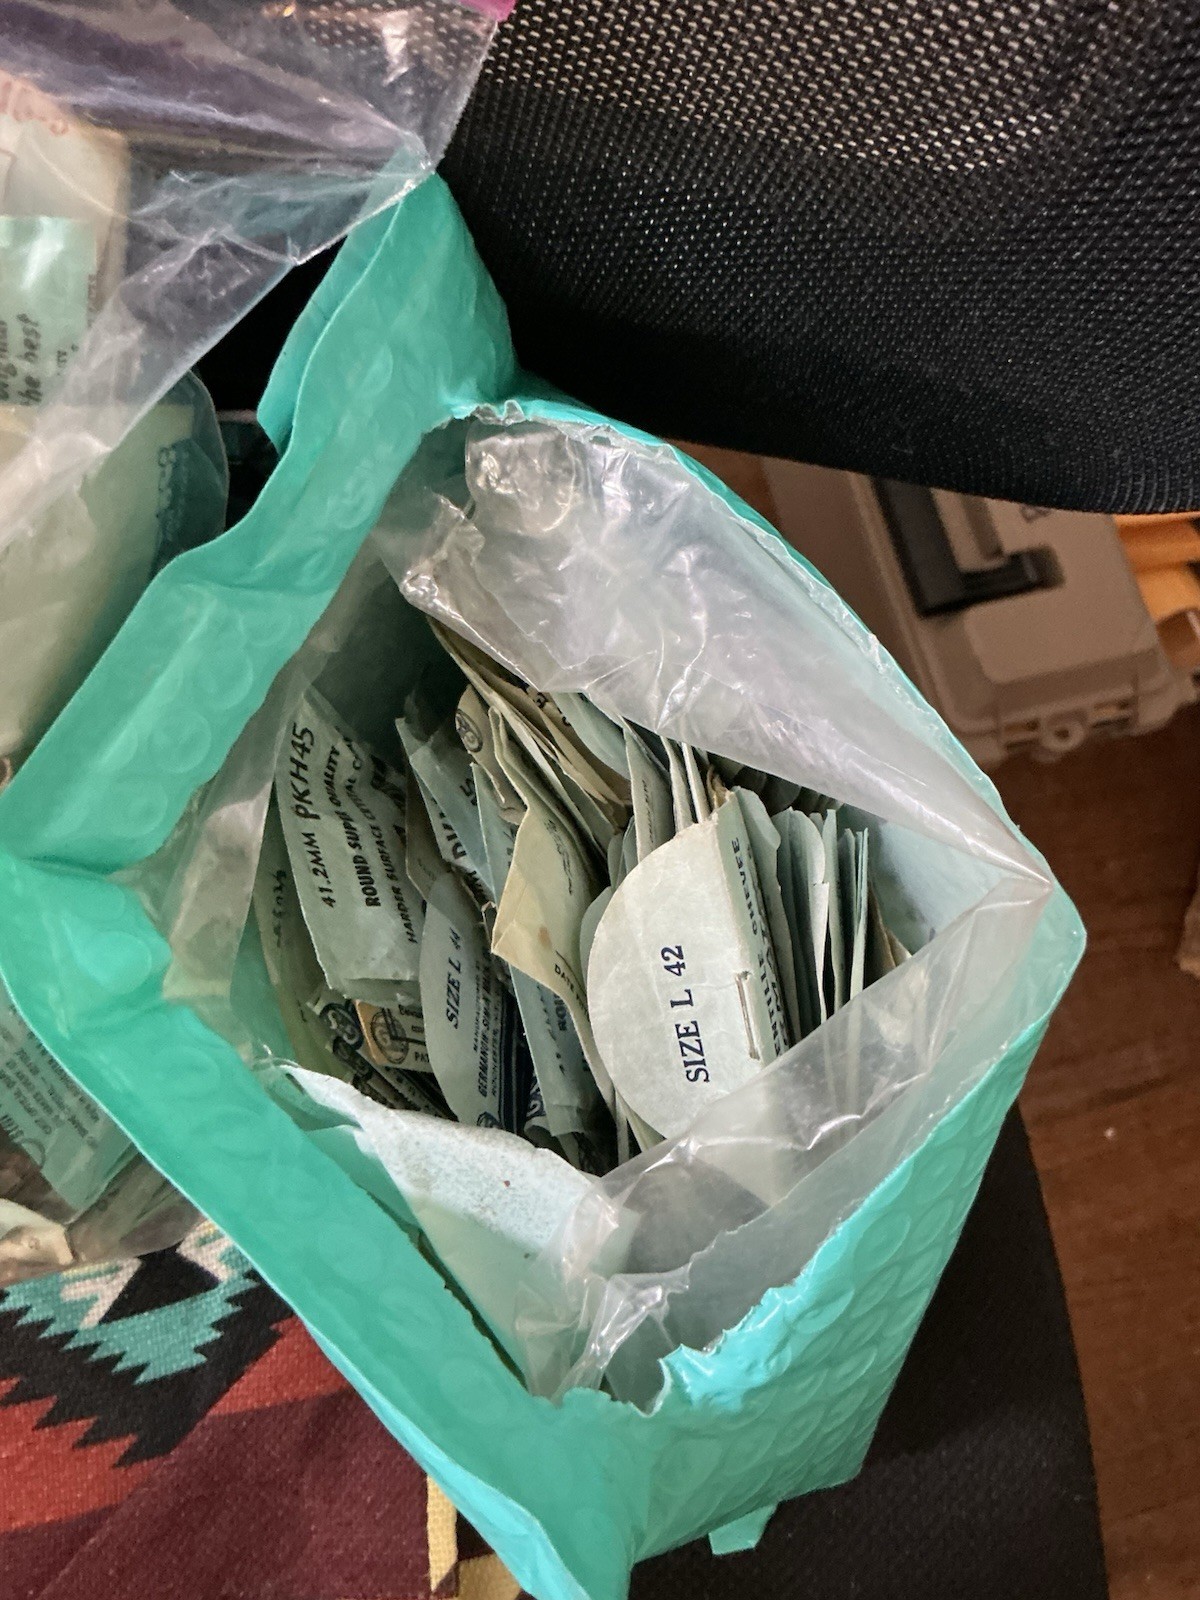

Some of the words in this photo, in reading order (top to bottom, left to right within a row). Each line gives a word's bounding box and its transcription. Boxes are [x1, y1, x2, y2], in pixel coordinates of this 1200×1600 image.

[288, 722, 321, 820] PKH45
[304, 832, 337, 909] 41.2MM
[355, 855, 382, 907] ROUND
[370, 825, 400, 882] SURFACE
[393, 886, 418, 944] HARDER
[447, 956, 462, 975] L
[660, 944, 687, 978] 42
[445, 973, 462, 1030] SIZE
[669, 987, 696, 1010] L
[674, 1019, 710, 1084] SIZE
